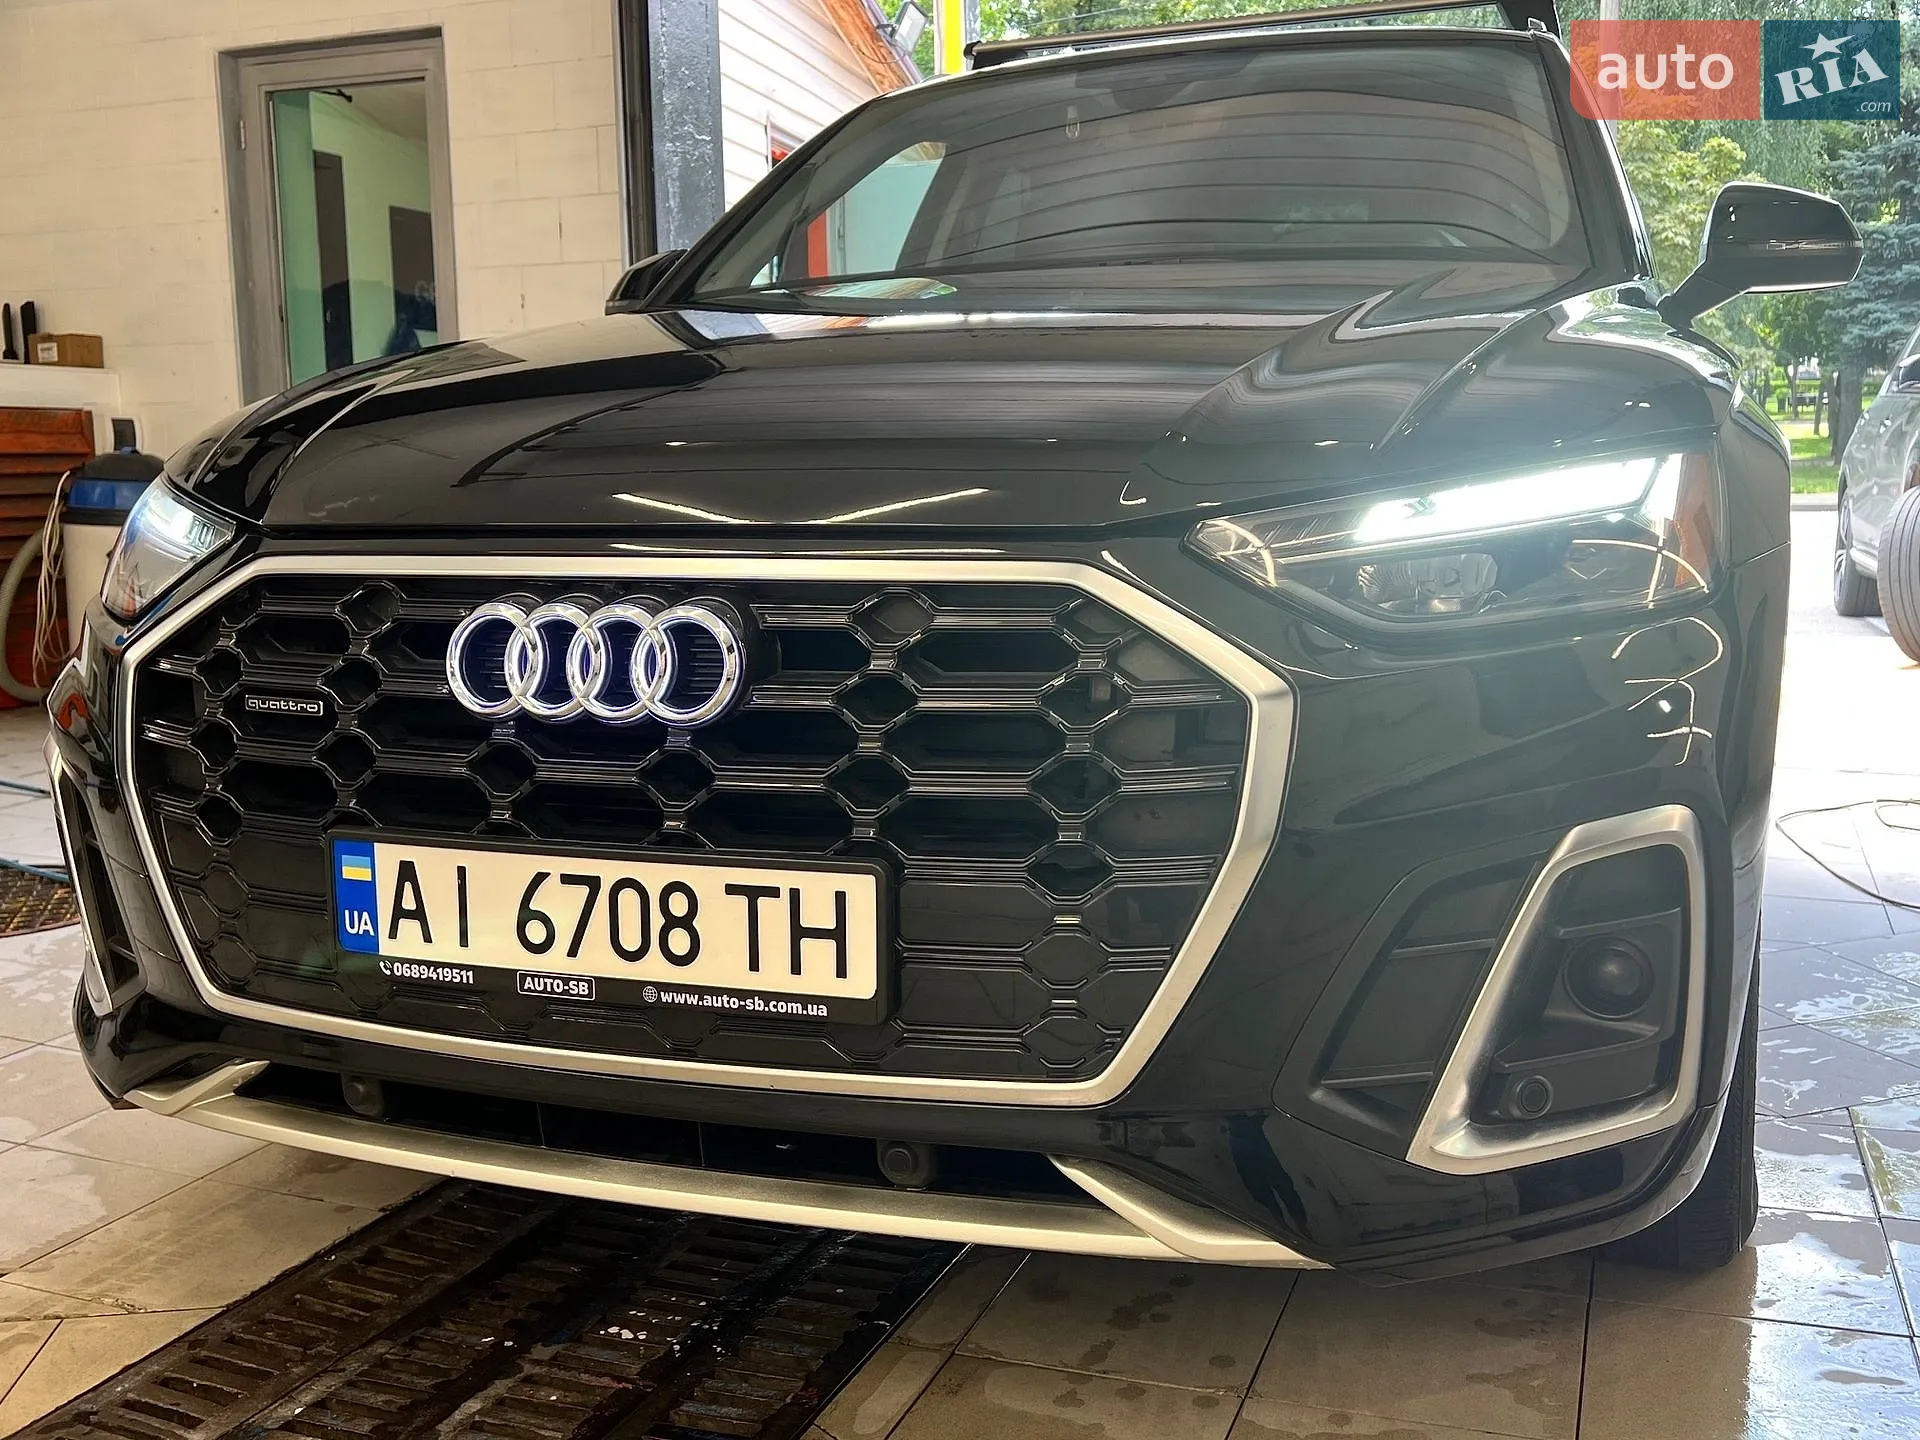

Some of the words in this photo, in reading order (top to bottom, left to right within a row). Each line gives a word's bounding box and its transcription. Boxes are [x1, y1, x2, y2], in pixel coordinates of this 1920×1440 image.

[248, 699, 318, 712] quattro
[344, 909, 375, 936] UA
[387, 859, 470, 949] AI
[515, 871, 701, 967] 6708
[724, 882, 847, 979] TH
[393, 962, 474, 984] 0689419511
[523, 976, 590, 995] AUTO-SB
[660, 991, 828, 1017] www.auto-sb.com.ua
